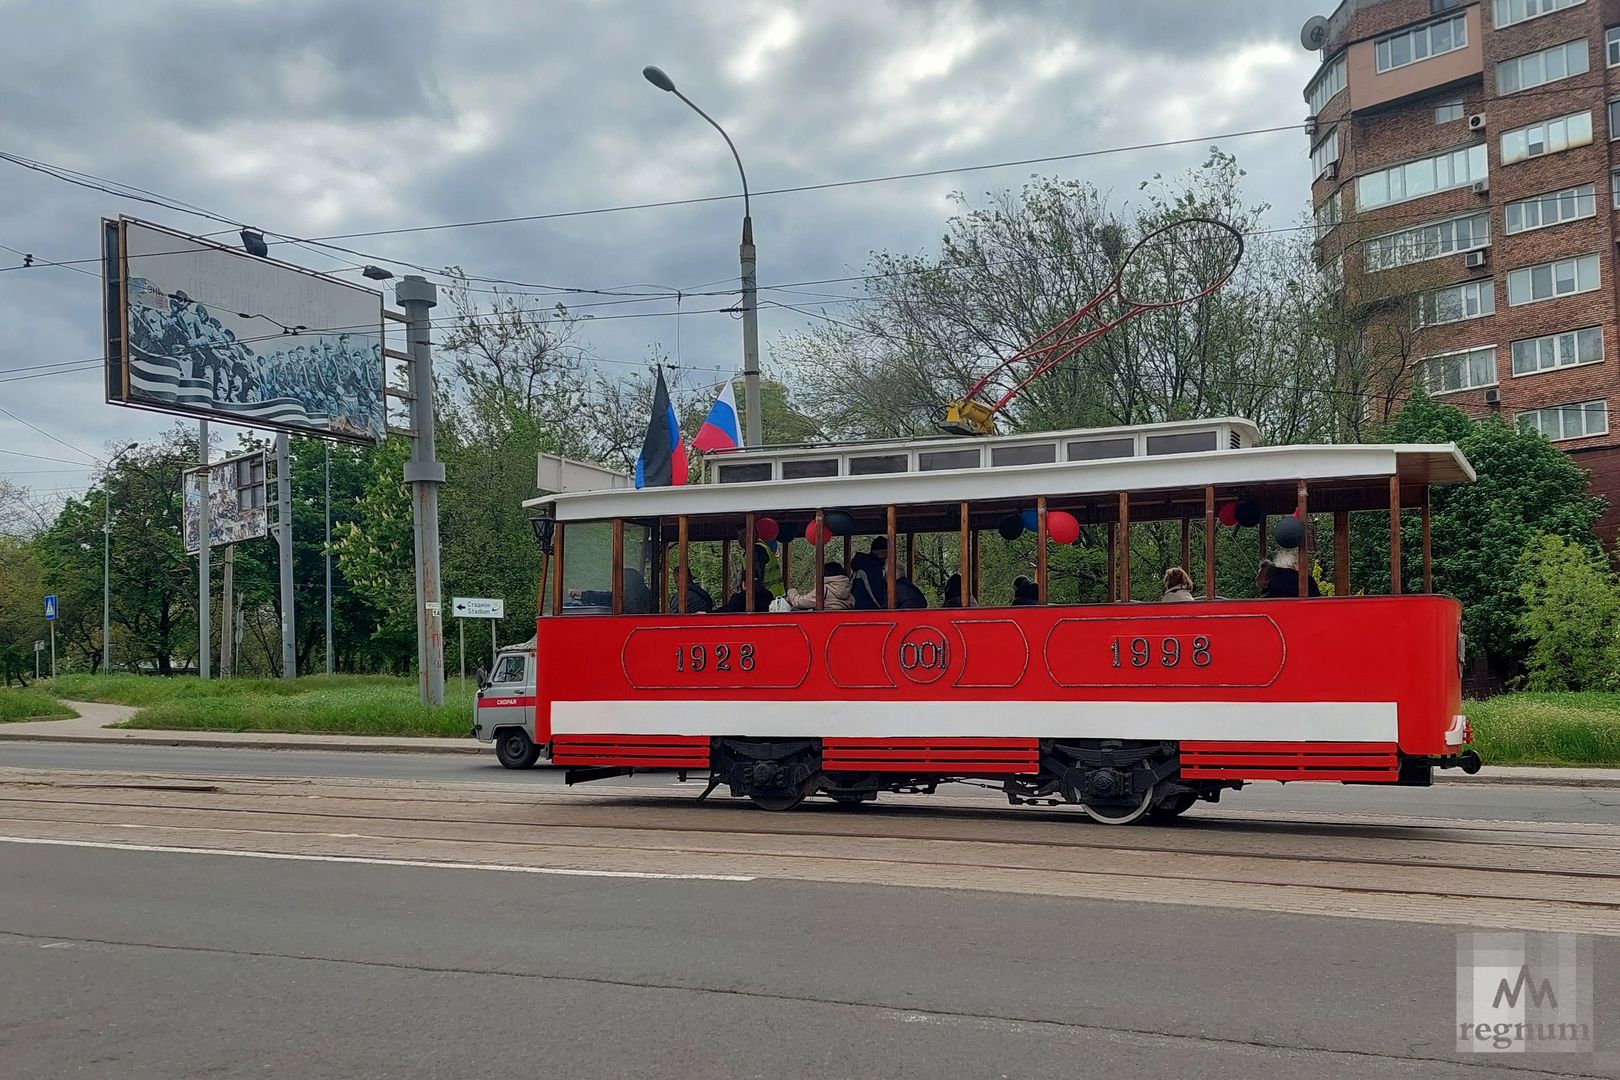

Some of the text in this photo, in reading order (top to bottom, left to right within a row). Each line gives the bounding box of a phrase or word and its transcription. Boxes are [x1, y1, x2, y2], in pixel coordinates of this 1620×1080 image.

[676, 643, 756, 672] 1928
[900, 640, 947, 669] 001
[1111, 636, 1213, 668] 1998
